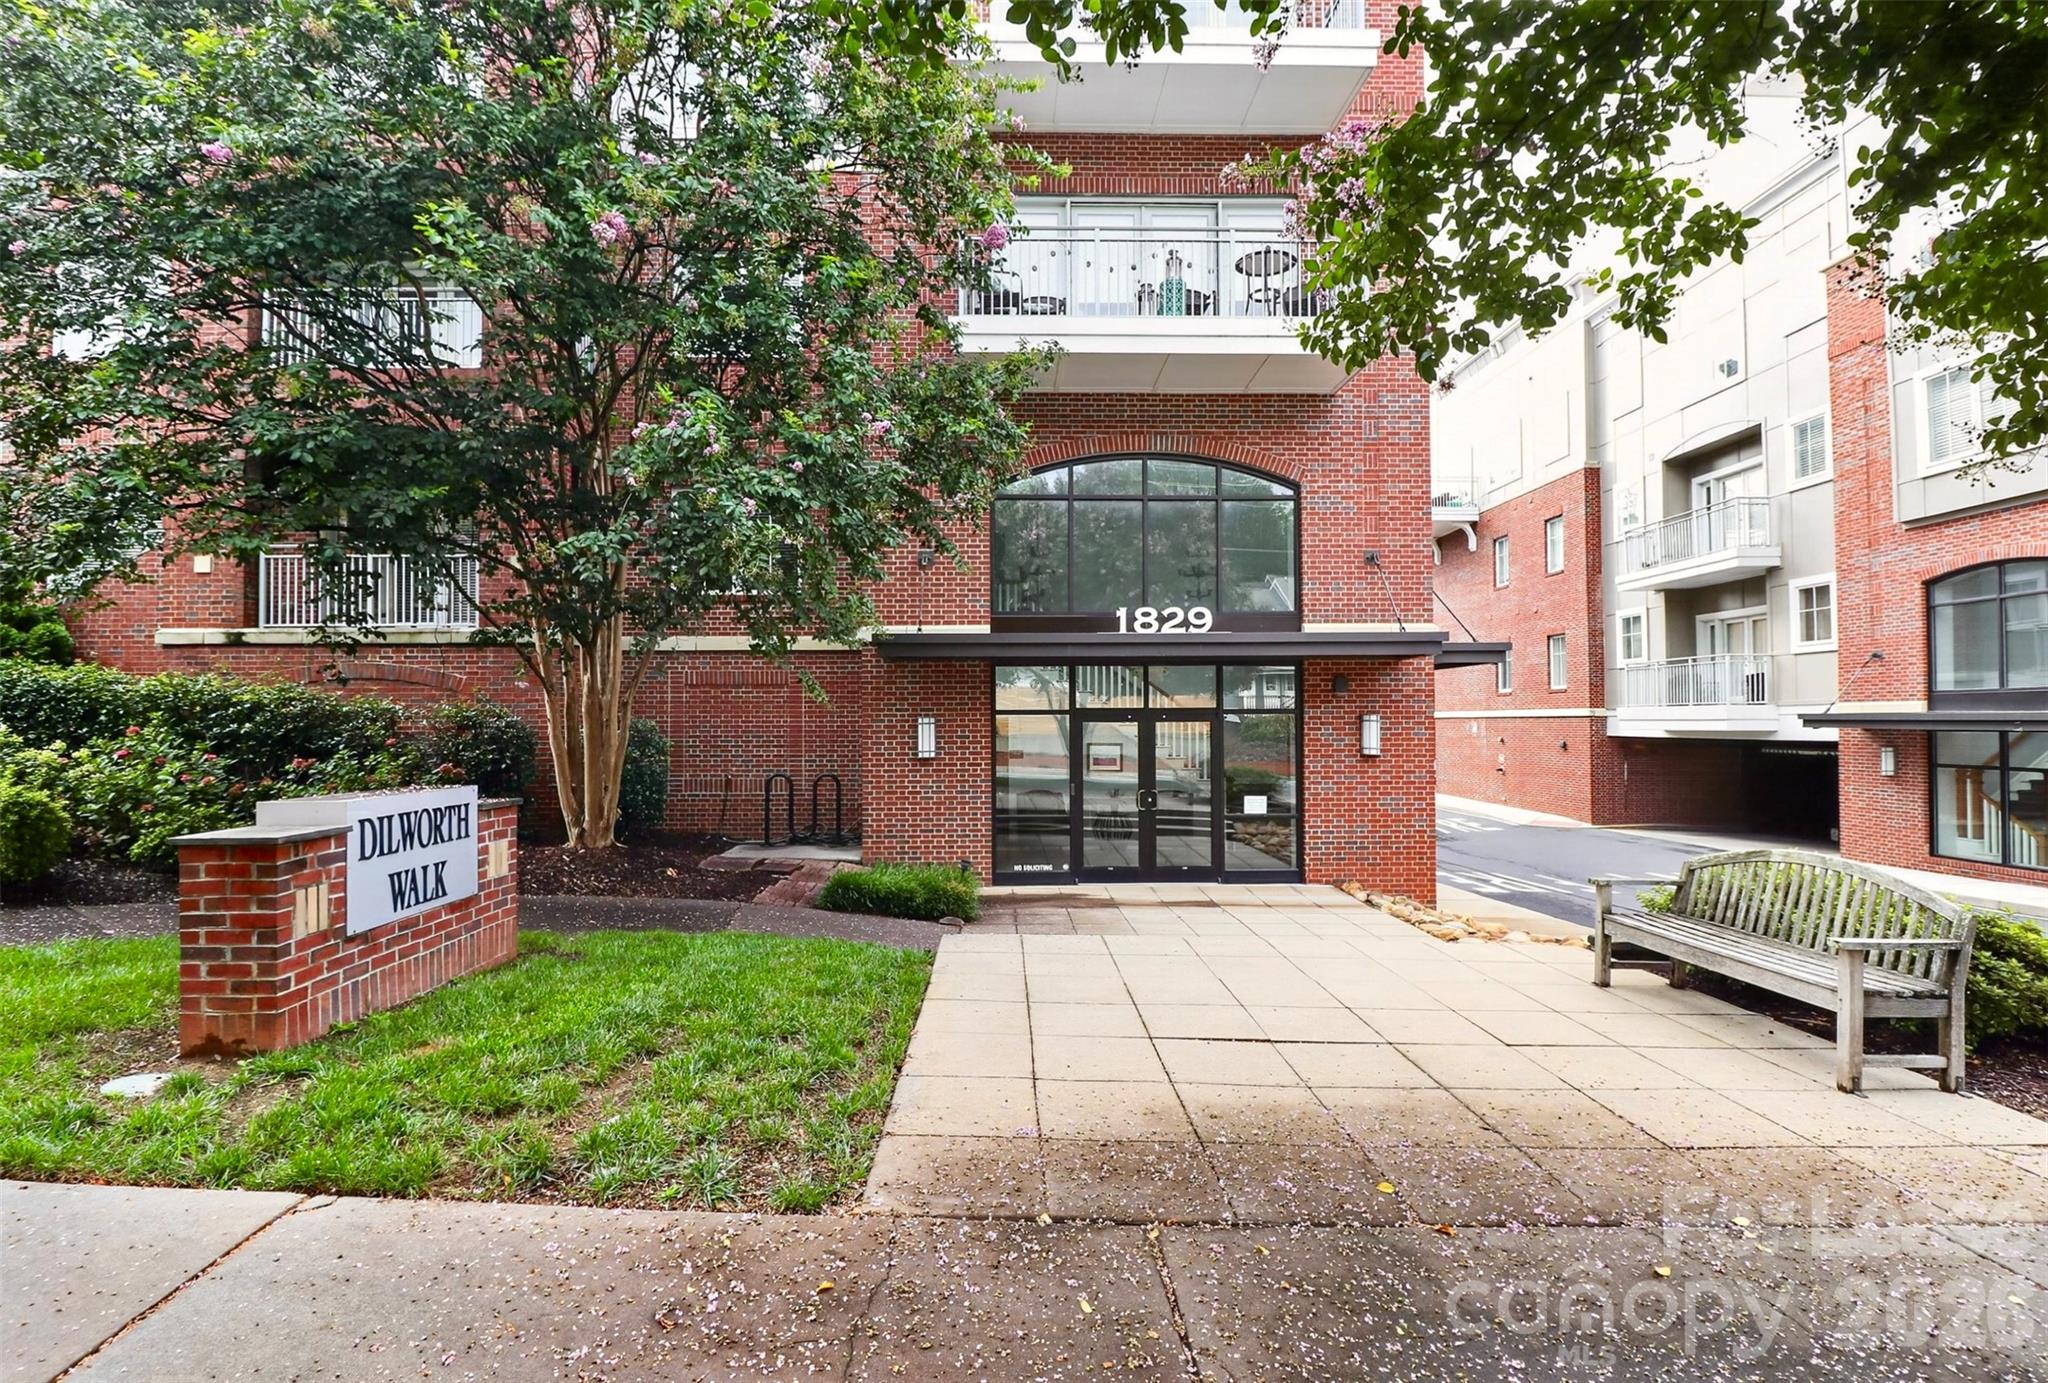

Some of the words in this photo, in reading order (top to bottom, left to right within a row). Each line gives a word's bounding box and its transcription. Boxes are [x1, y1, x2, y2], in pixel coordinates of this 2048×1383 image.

[1115, 606, 1213, 634] 1829
[358, 802, 471, 862] DILWORTH
[387, 860, 448, 914] WALK
[1013, 864, 1022, 872] NO
[1023, 863, 1053, 872] SOLICITING
